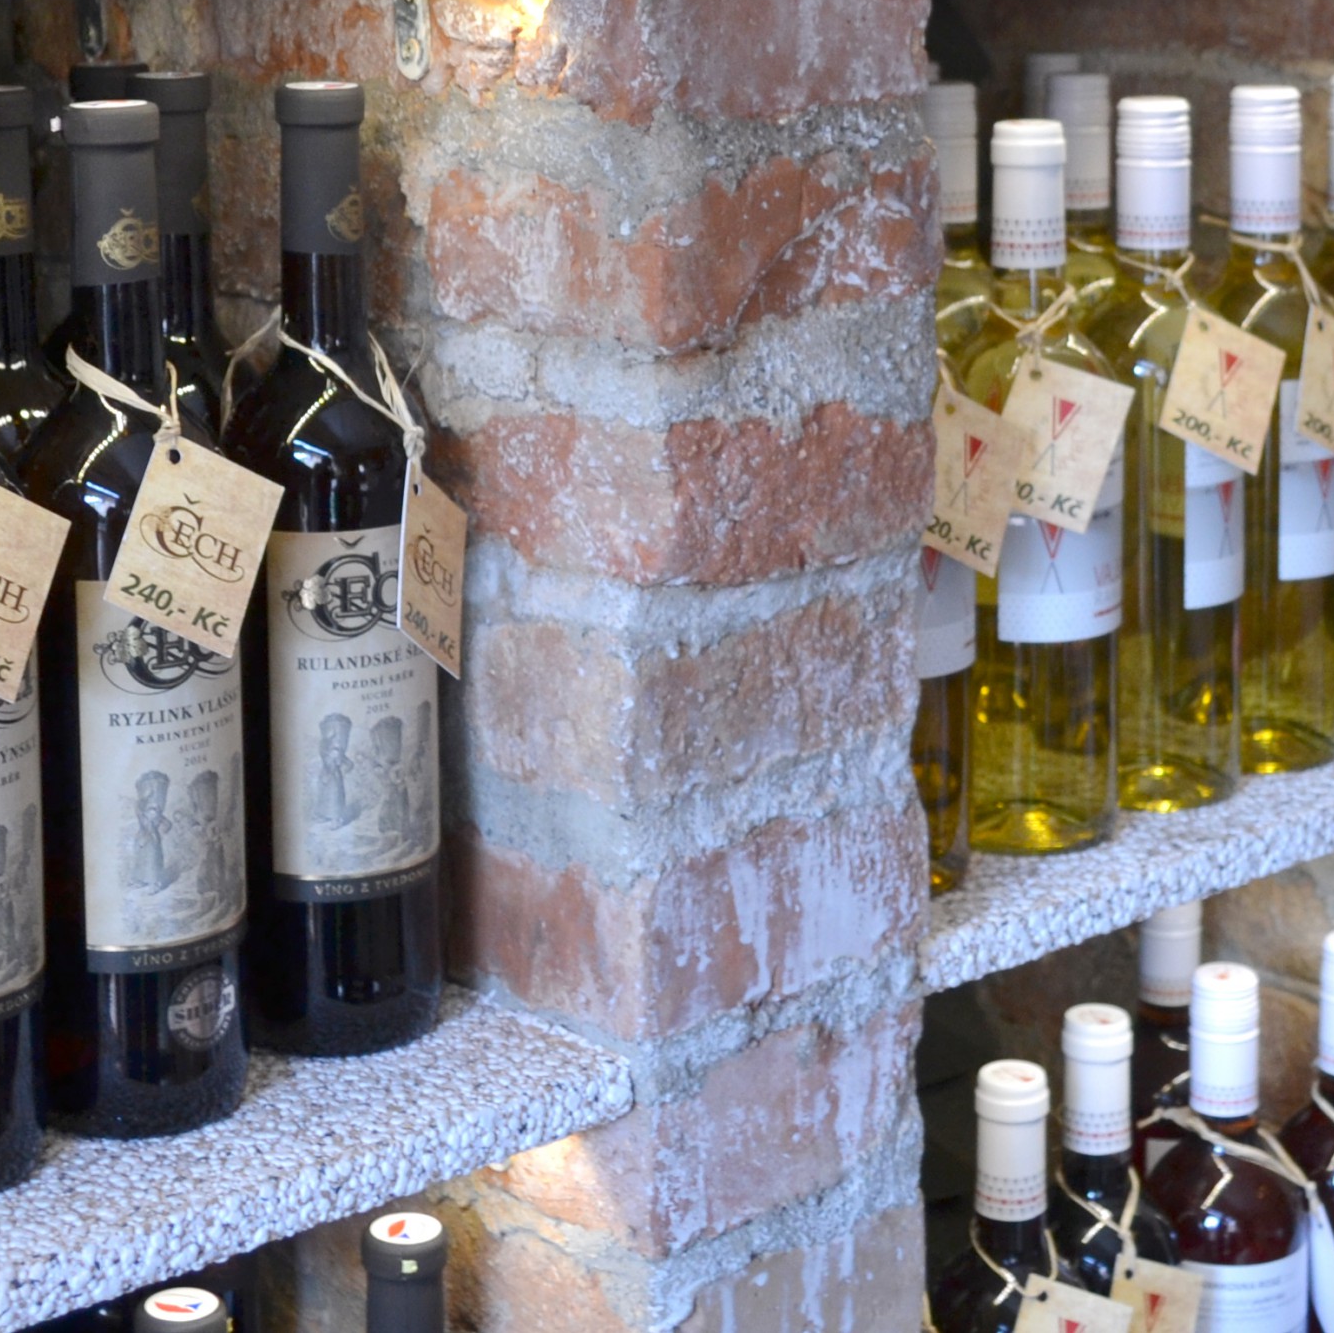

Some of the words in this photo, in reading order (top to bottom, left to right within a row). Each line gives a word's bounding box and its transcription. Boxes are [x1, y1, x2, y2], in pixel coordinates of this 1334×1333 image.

[1050, 493, 1085, 517] Kč
[965, 535, 994, 561] Kč
[120, 574, 186, 617] 240,-
[191, 606, 231, 638] Kč
[404, 602, 435, 642] 240,-
[438, 630, 457, 660] Kč
[297, 647, 402, 672] RULANDSKÉ
[332, 674, 386, 691] POZDNÍ
[108, 704, 194, 728] RYZLINK
[135, 721, 212, 746] KABINETNÍ
[314, 880, 354, 897] VÍNO
